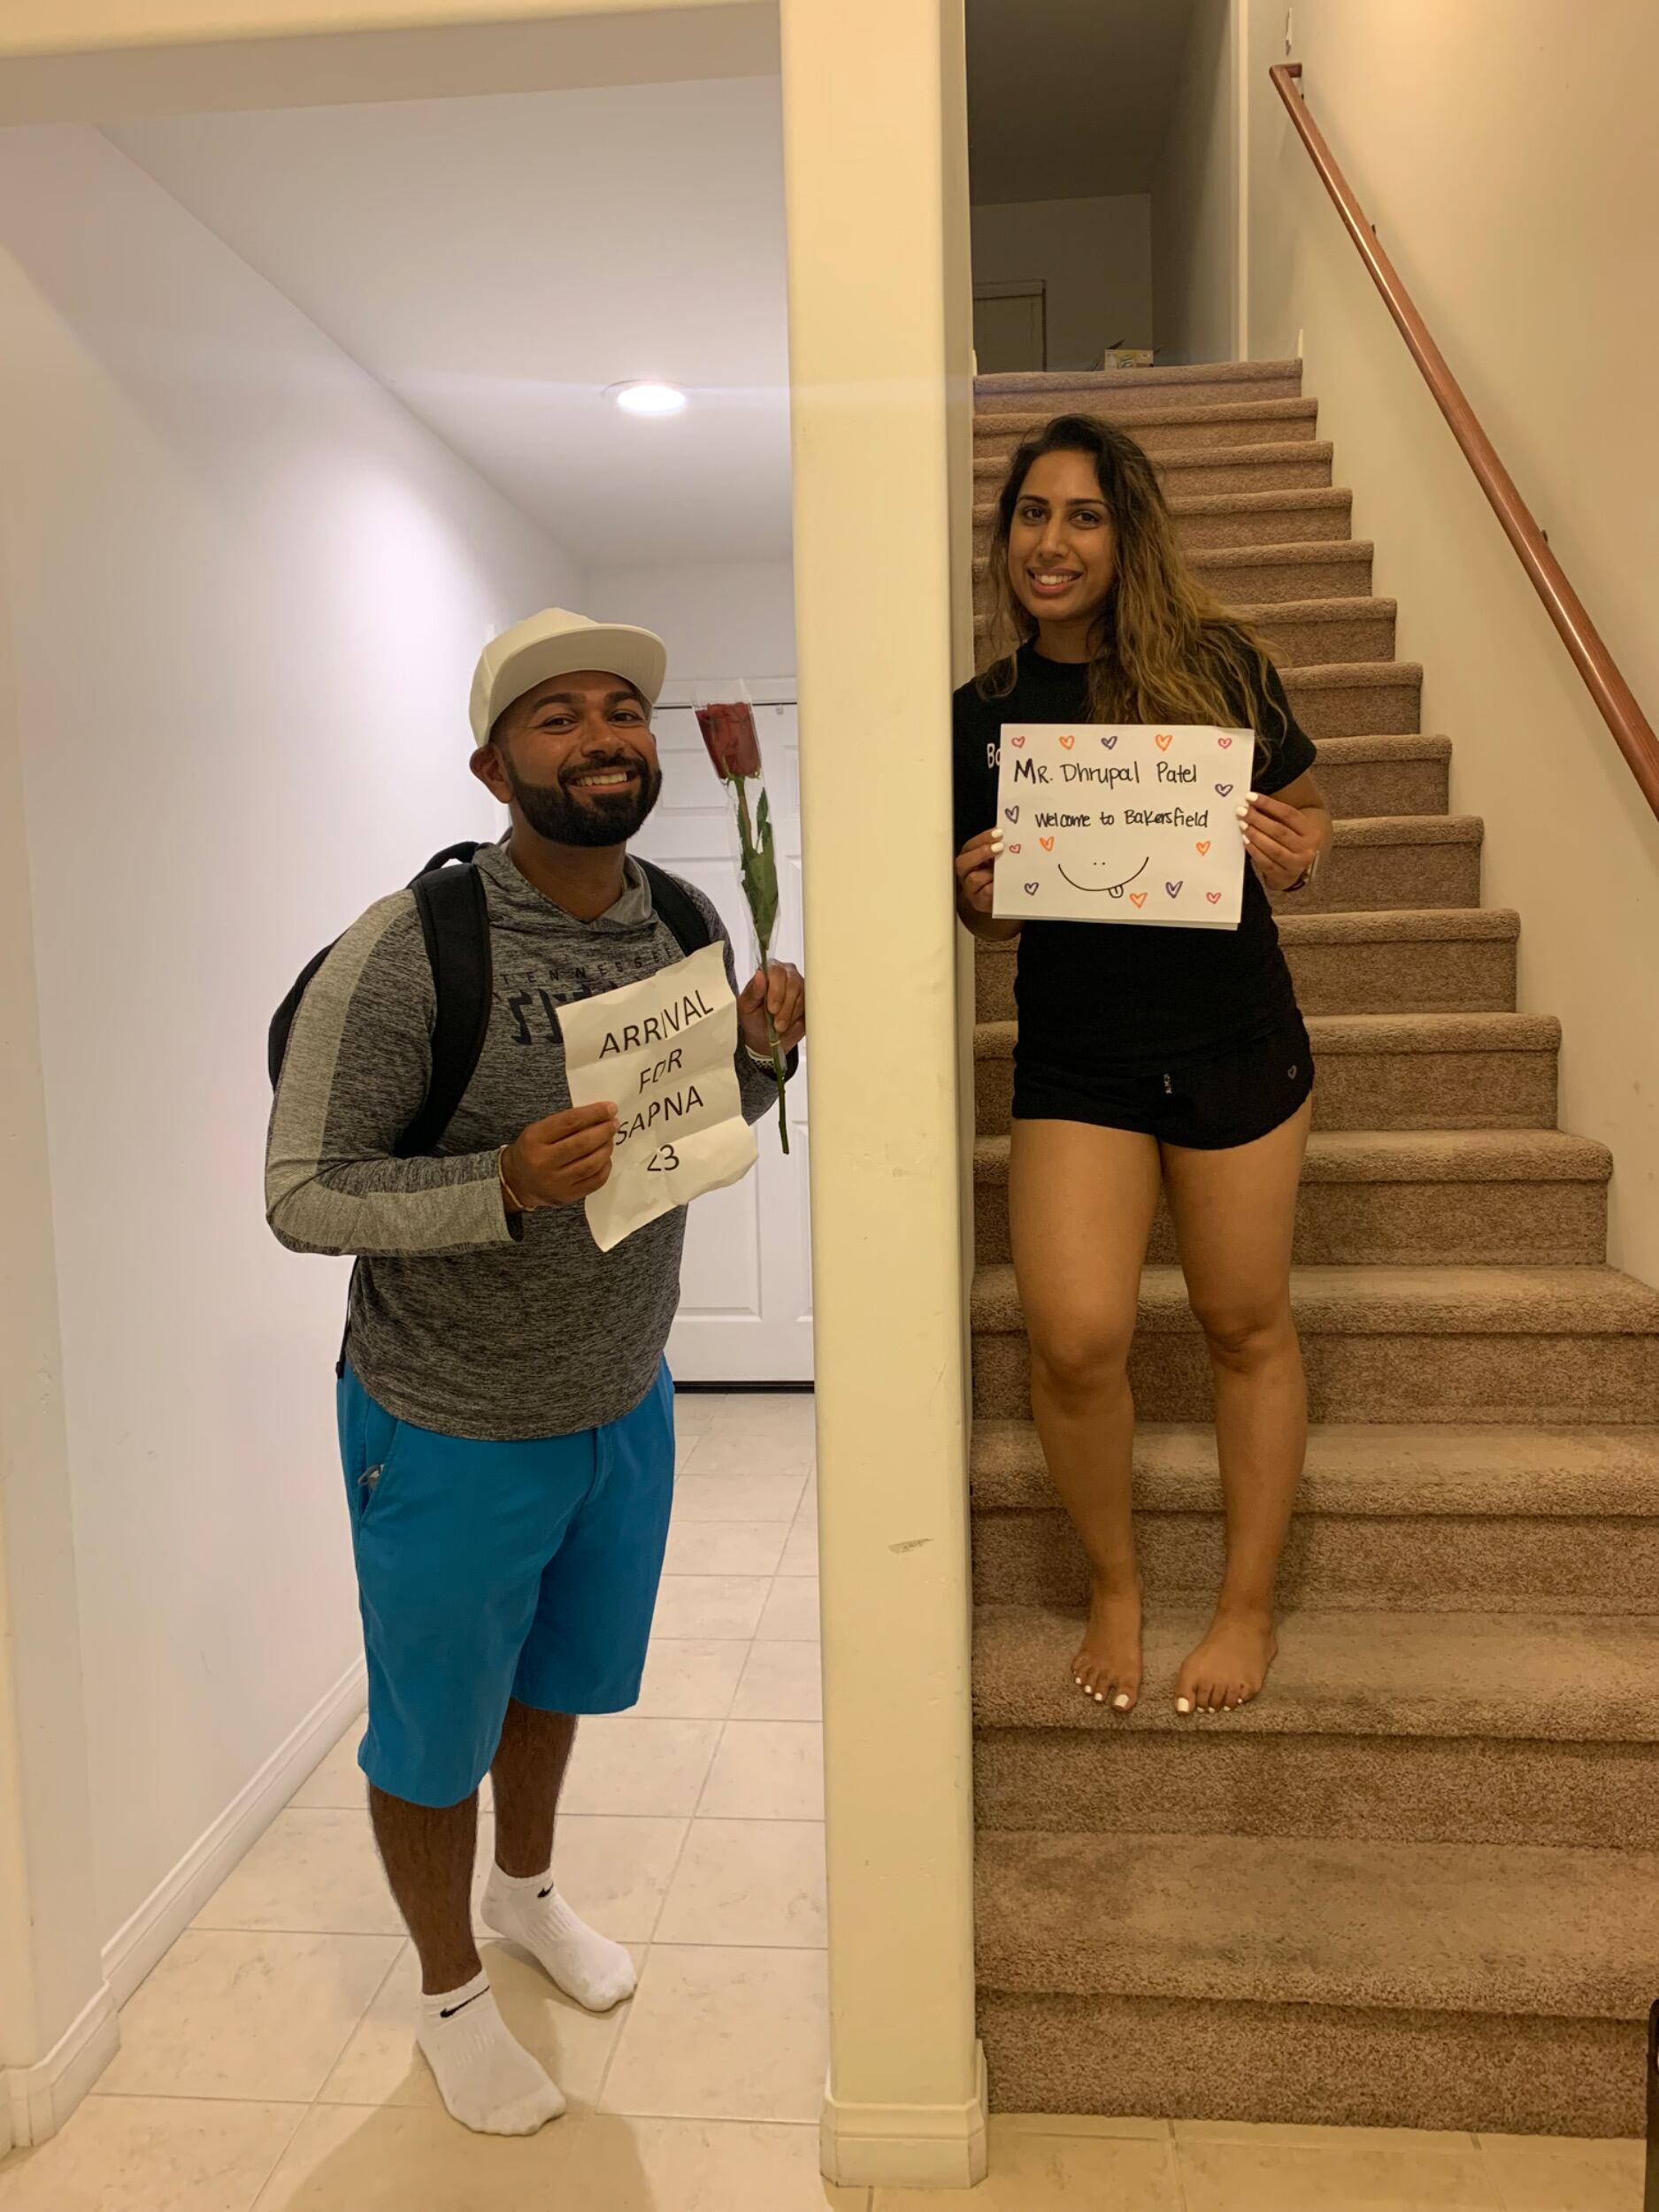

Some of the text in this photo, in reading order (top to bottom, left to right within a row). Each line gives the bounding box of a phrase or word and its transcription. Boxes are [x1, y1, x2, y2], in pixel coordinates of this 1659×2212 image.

[1059, 761, 1140, 790] Dhrupal
[1156, 761, 1197, 784] Patel
[1035, 810, 1092, 828] Welcome
[1100, 811, 1116, 826] to
[598, 989, 715, 1059] ARRIVAL
[638, 1048, 683, 1094] FOR
[615, 1085, 704, 1146] SAPNA
[646, 1143, 680, 1172] <3
